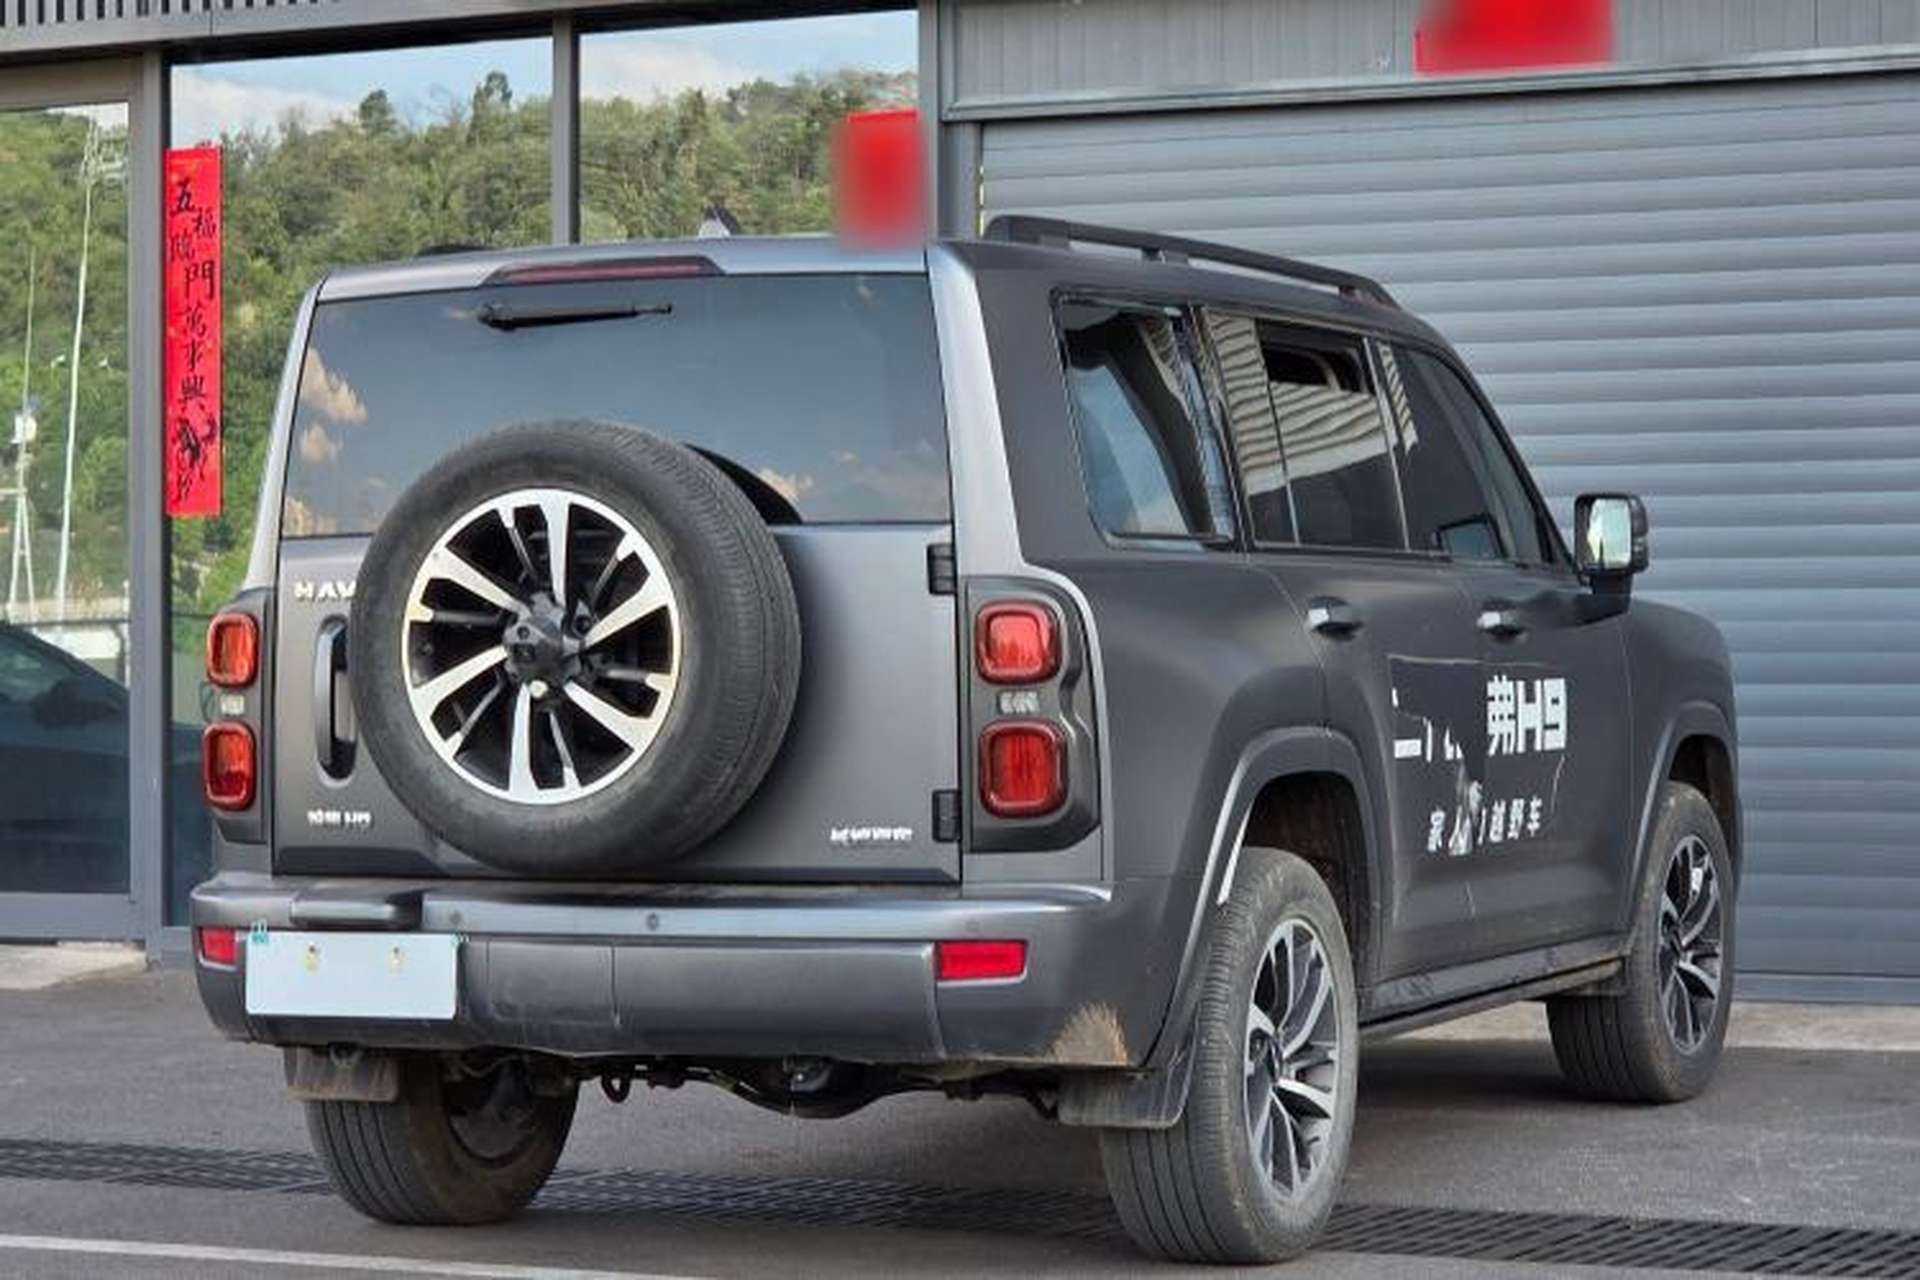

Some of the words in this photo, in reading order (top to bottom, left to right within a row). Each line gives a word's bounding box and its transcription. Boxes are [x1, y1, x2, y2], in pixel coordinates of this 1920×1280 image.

[294, 580, 357, 598] HAV
[1427, 795, 1543, 854] 家越野车
